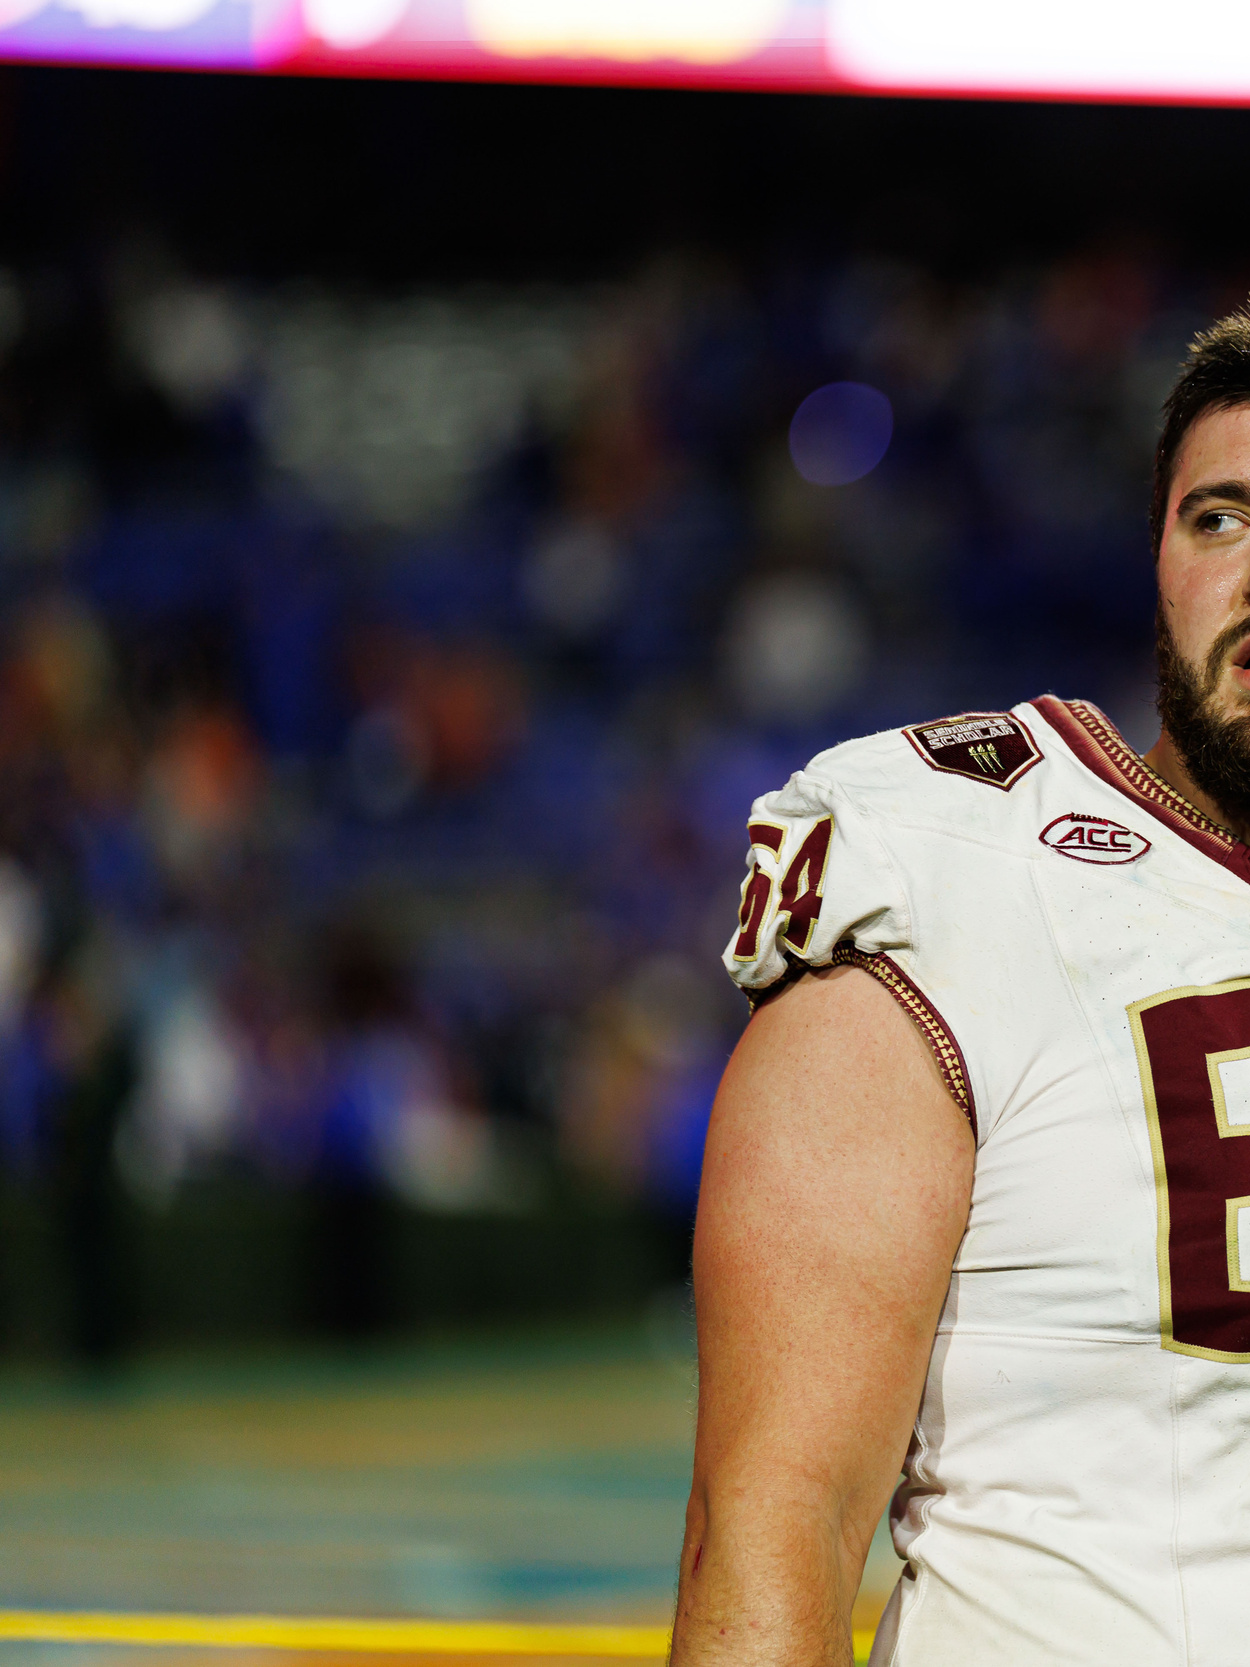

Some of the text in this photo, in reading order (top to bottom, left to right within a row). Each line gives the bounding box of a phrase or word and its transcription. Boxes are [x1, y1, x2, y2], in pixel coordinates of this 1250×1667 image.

[928, 725, 1015, 749] SCHOLAR
[1057, 828, 1131, 848] ACC
[733, 814, 834, 961] 64
